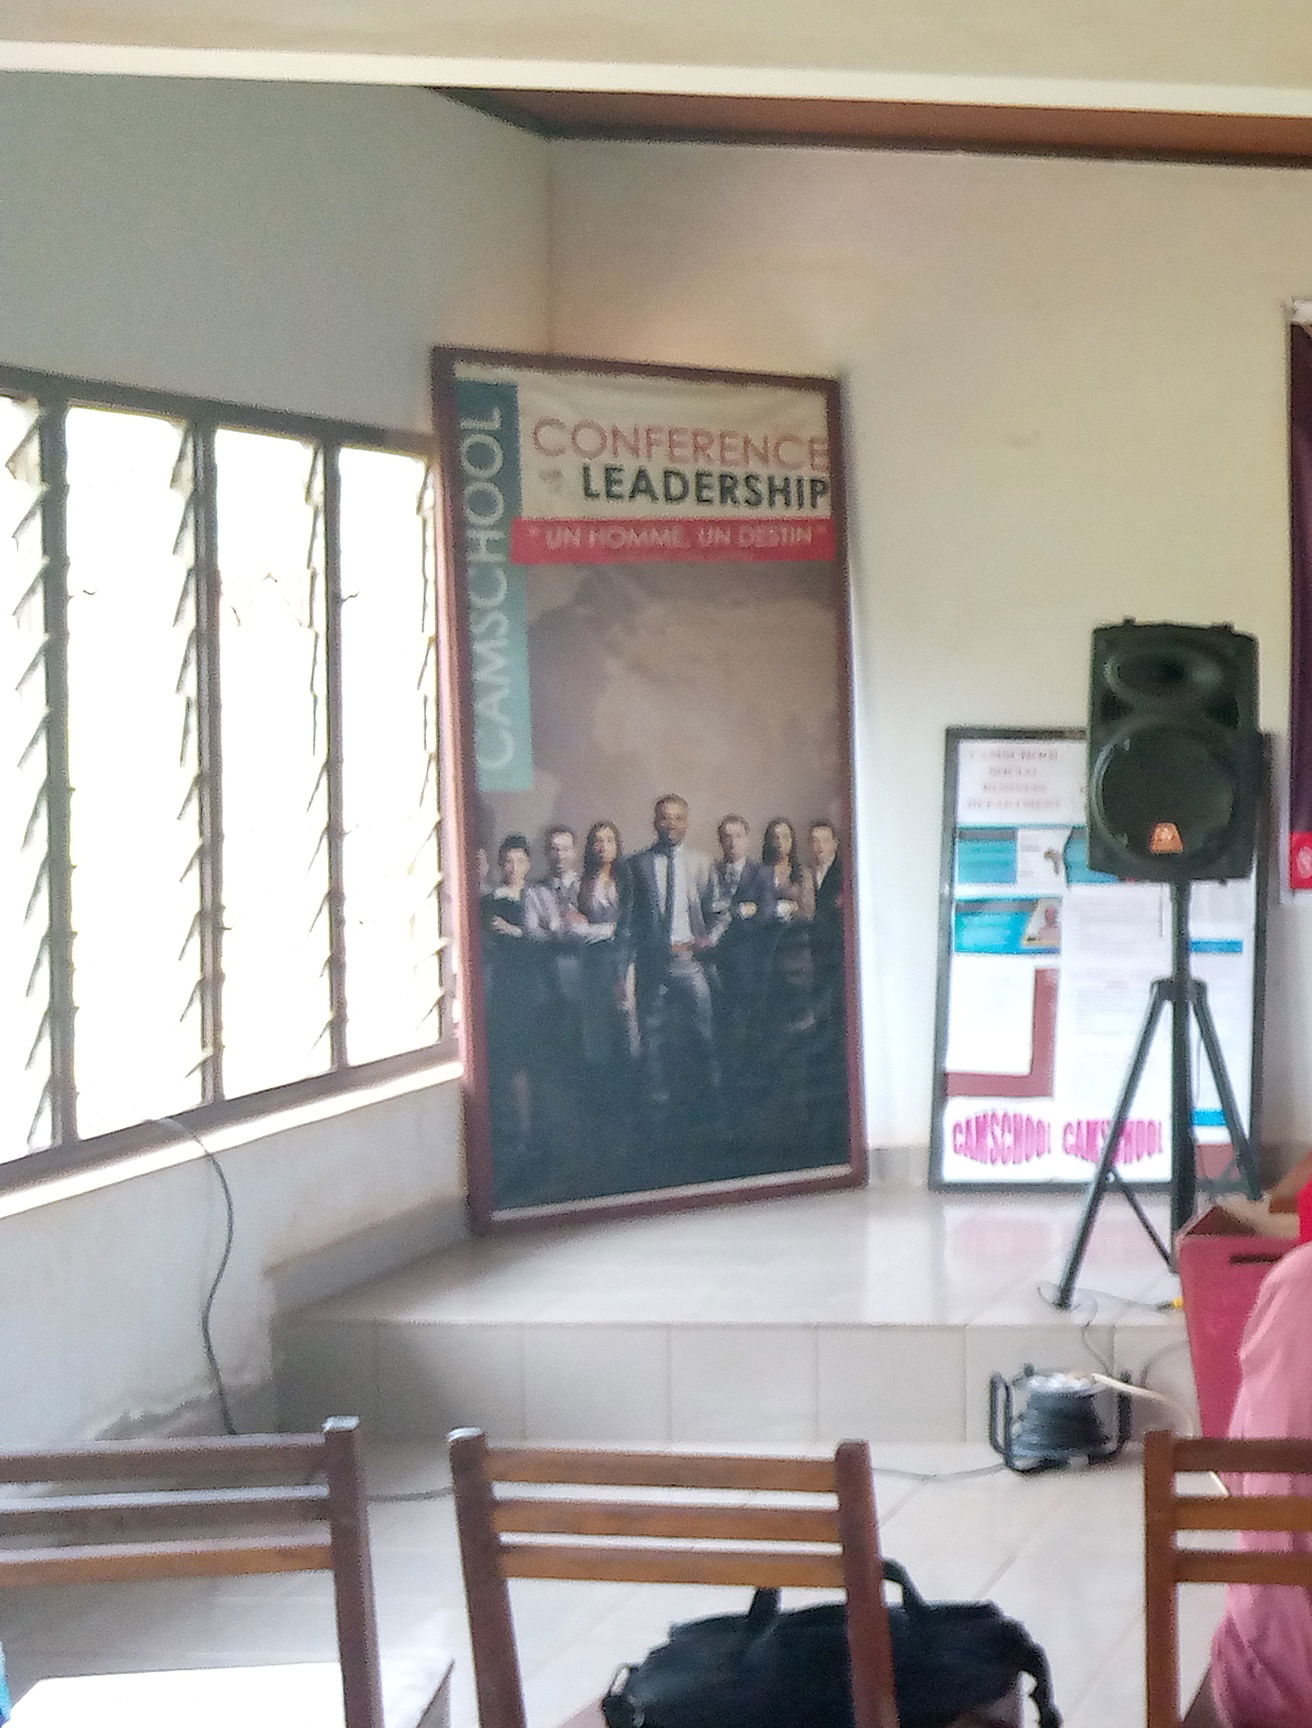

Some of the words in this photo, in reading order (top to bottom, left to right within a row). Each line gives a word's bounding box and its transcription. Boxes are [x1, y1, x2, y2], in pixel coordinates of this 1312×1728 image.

[532, 416, 830, 473] CONFERENCE
[582, 462, 830, 510] LEADERSHIP
[460, 407, 518, 775] CAMSCHOOL
